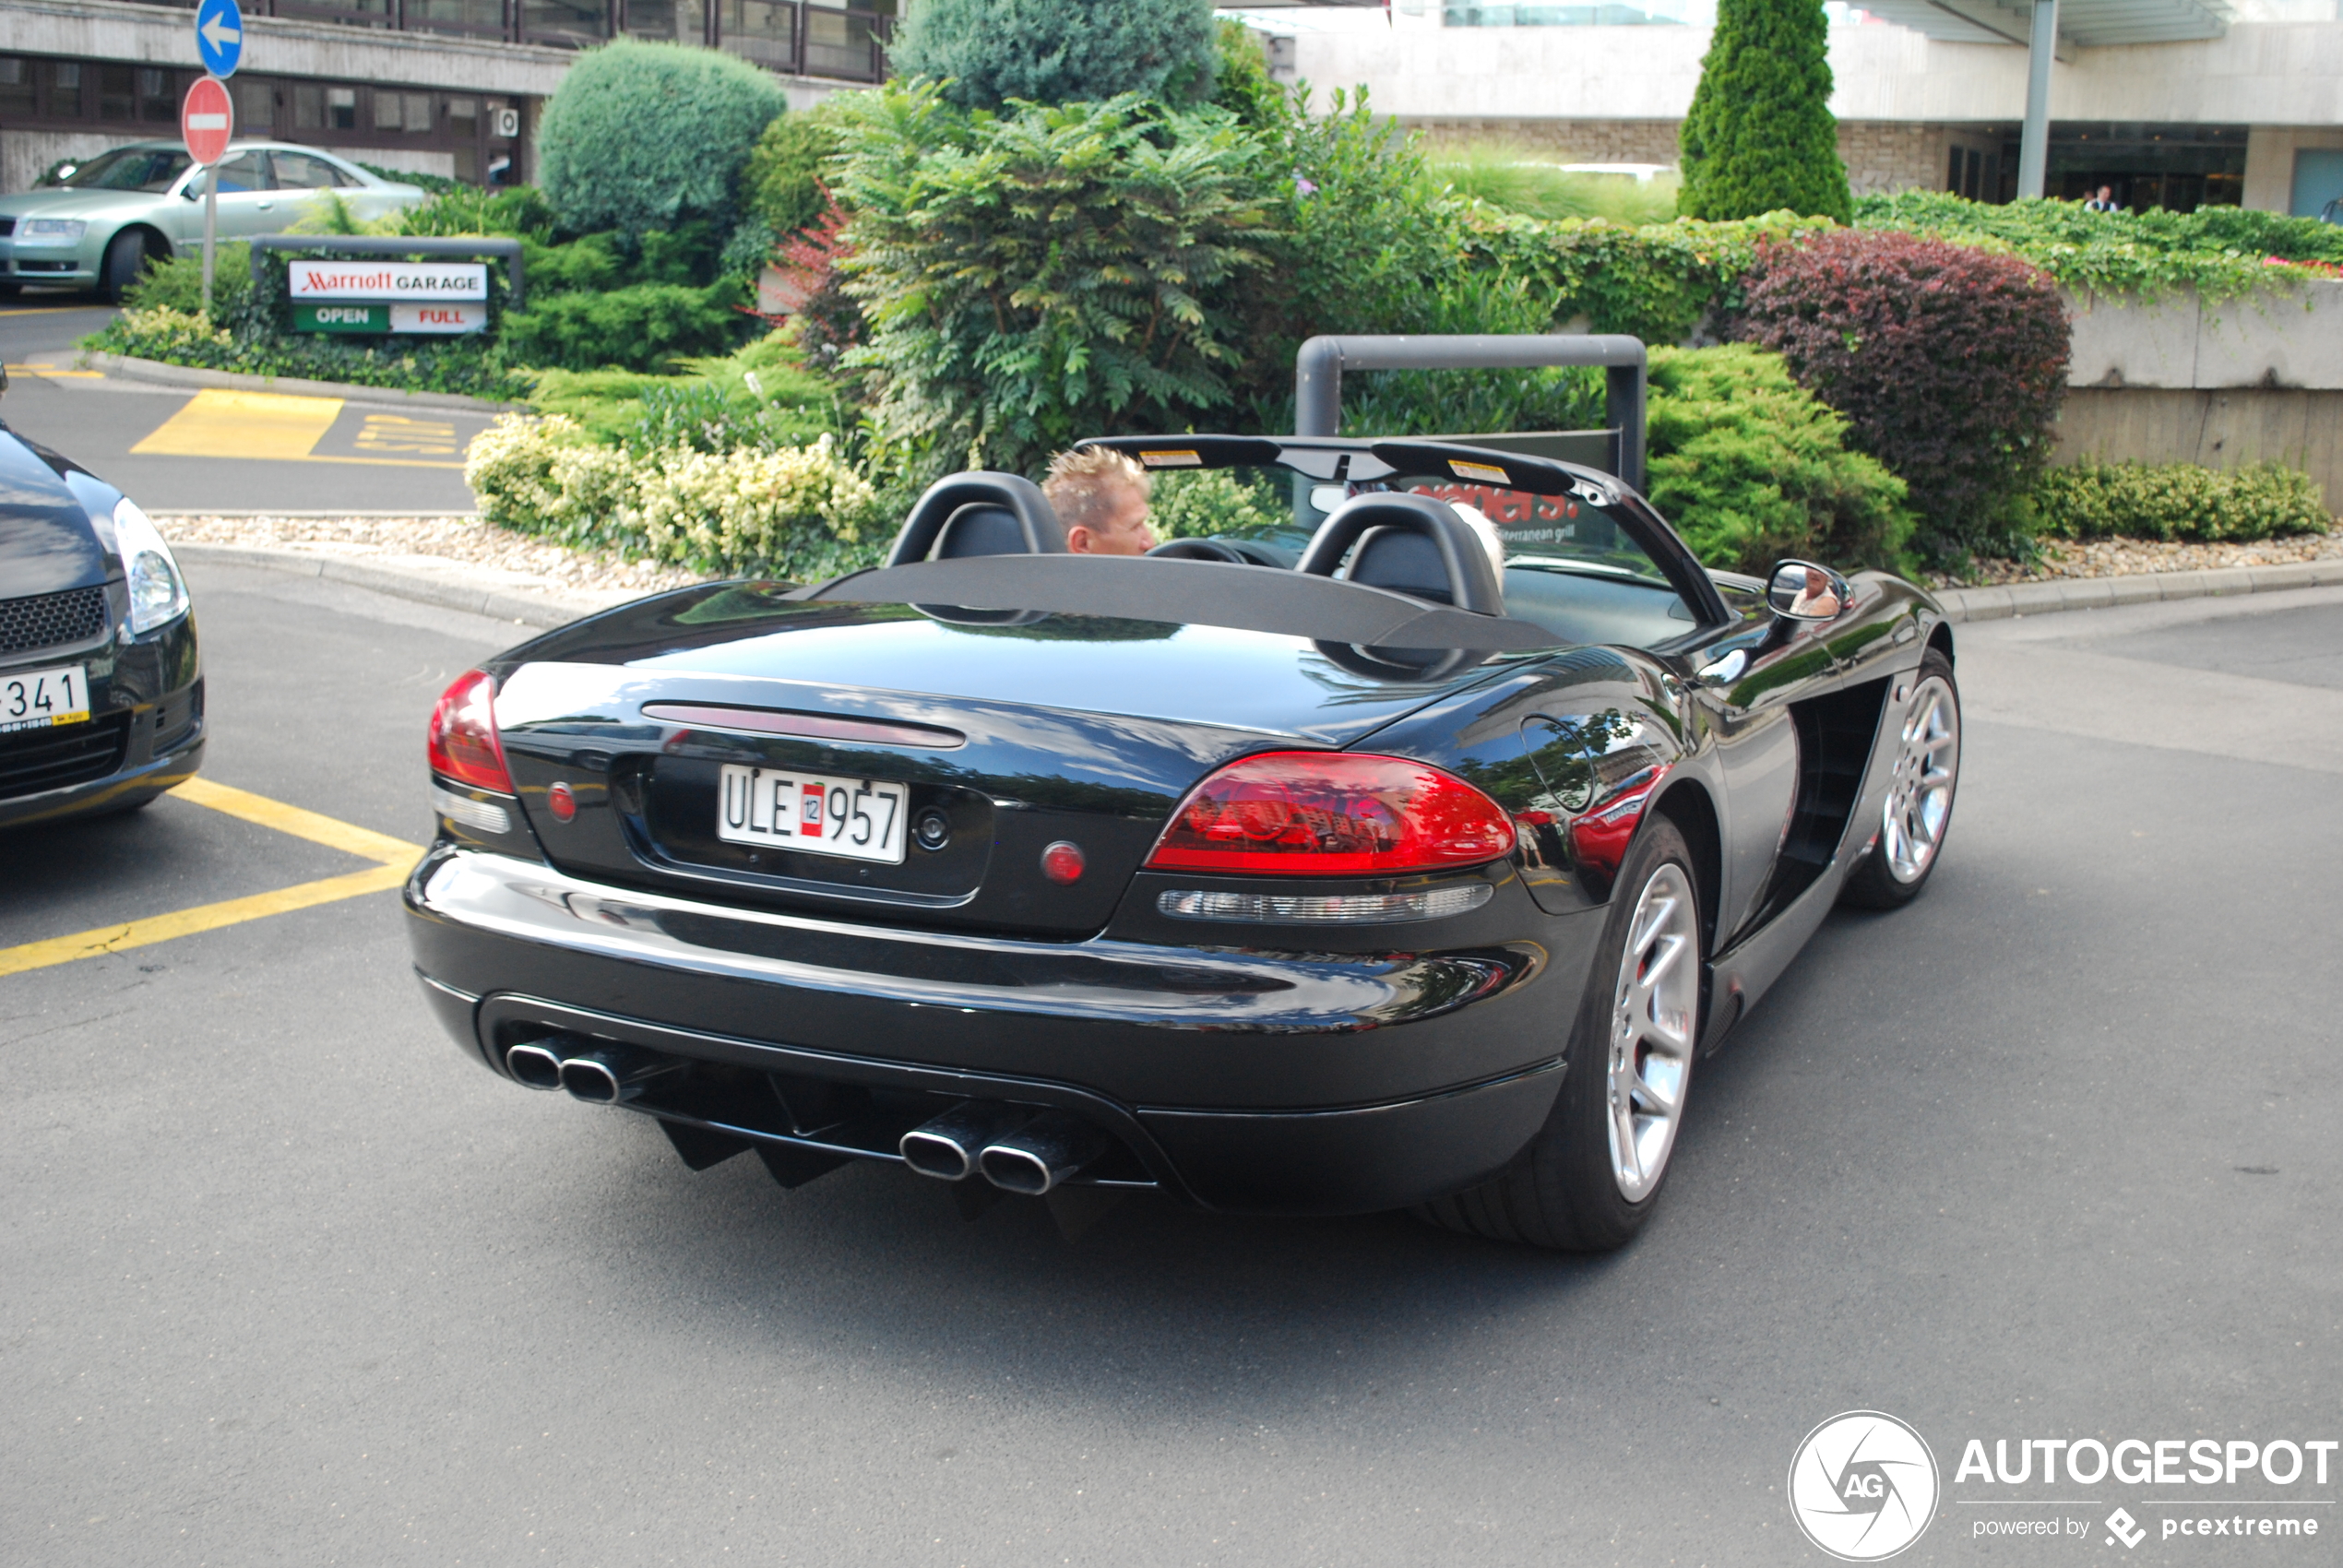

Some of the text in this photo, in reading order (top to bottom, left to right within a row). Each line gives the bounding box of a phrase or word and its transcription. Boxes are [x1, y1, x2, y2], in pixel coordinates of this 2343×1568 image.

[301, 271, 479, 291] Marriott GARAGE
[315, 307, 369, 324] OPEN
[420, 310, 465, 324] FULL
[1554, 524, 1575, 543] grill
[0, 674, 73, 717] 341
[726, 774, 898, 849] ULE 957
[803, 800, 817, 820] 12
